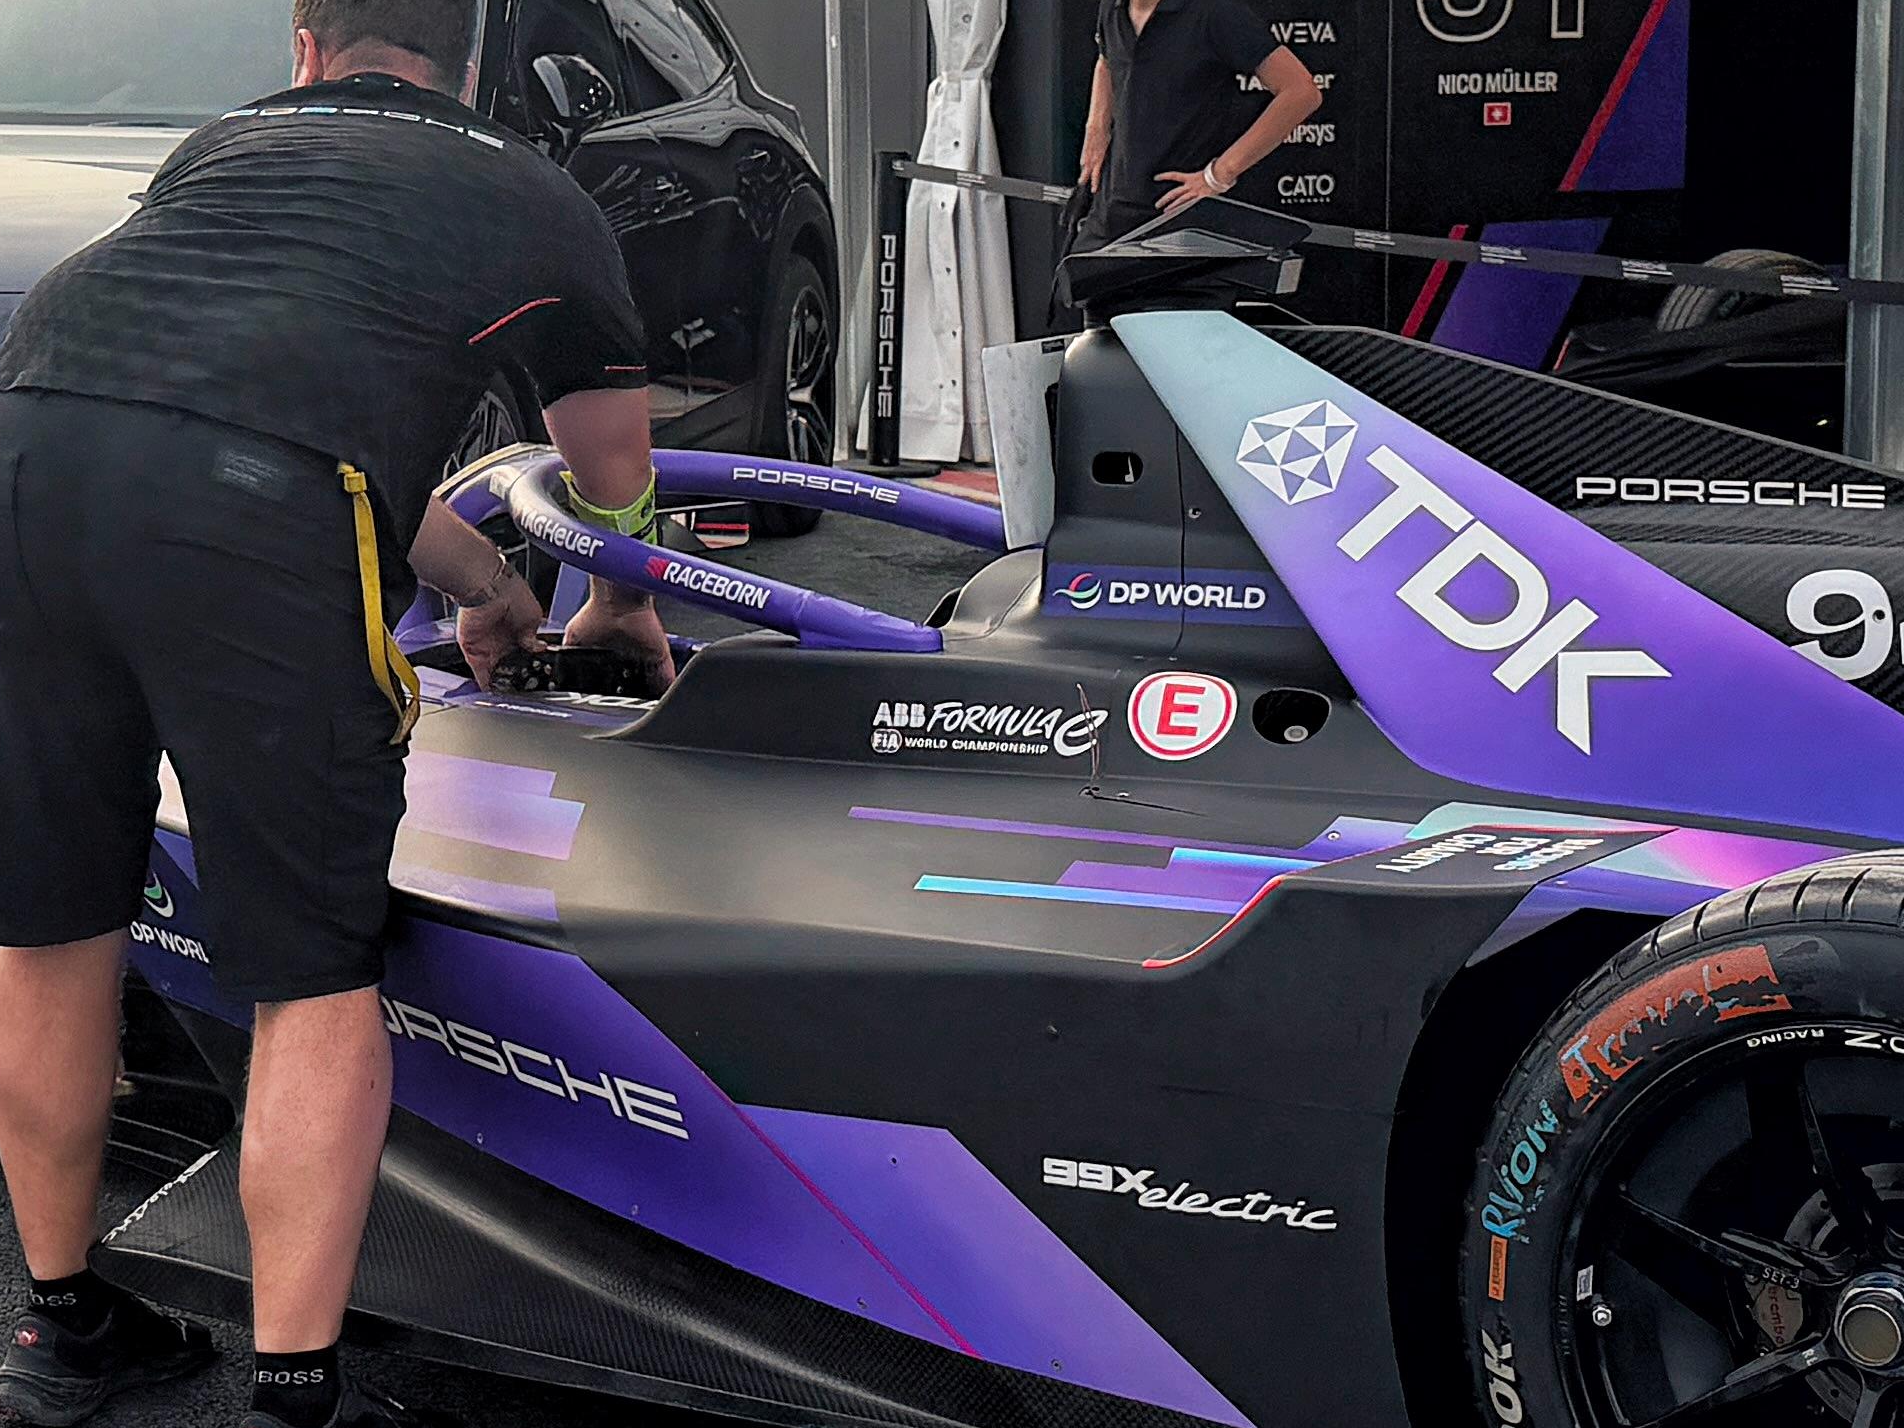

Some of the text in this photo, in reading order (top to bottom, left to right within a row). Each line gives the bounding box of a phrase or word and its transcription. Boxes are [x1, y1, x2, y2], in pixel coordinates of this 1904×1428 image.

[1438, 68, 1559, 96] NICO MÜLLER
[1277, 173, 1336, 198] CATO
[876, 234, 897, 418] PORSCHE
[732, 466, 901, 504] PORSCHE
[1575, 475, 1887, 511] PORSCHE
[549, 525, 604, 559] Heuer
[662, 559, 772, 610] RACEBORN
[1108, 580, 1266, 611] DP WORLD
[1336, 443, 1673, 756] TDK
[873, 702, 926, 728] ABB
[926, 702, 1064, 740] FORMULA
[1155, 682, 1209, 738] E
[904, 738, 948, 751] WORLD
[951, 739, 1049, 755] CHAMPIONSHIP
[154, 926, 211, 964] WORL
[1746, 1027, 1825, 1049] RACING
[382, 995, 692, 1140] ORSCHE
[1042, 1154, 1338, 1233] 99X electric
[258, 1368, 325, 1385] BOSS
